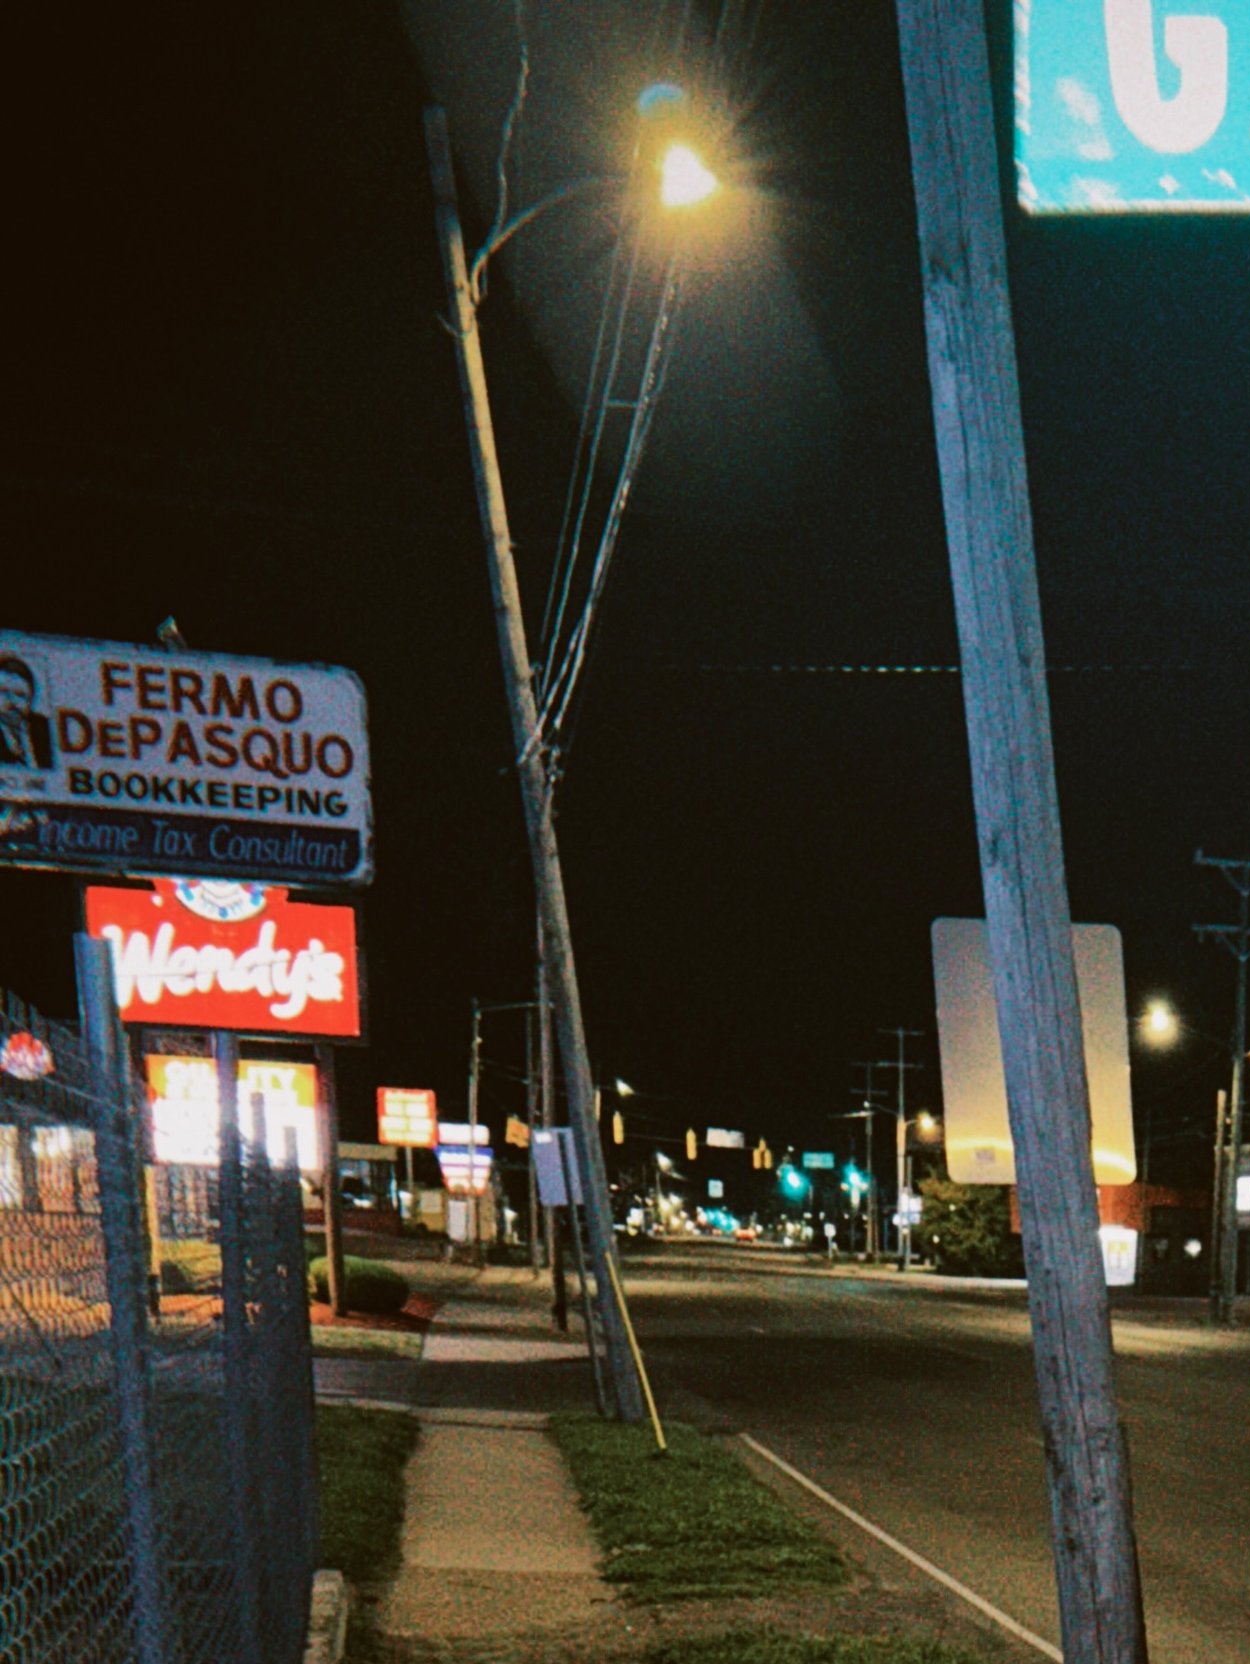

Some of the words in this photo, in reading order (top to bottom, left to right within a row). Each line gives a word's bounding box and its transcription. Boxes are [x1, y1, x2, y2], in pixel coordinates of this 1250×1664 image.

[100, 660, 304, 723] FERMO
[68, 766, 348, 816] BOOKKEEPING
[152, 819, 197, 857] Tax
[208, 823, 348, 868] Consultant
[101, 920, 345, 1020] Wendy's
